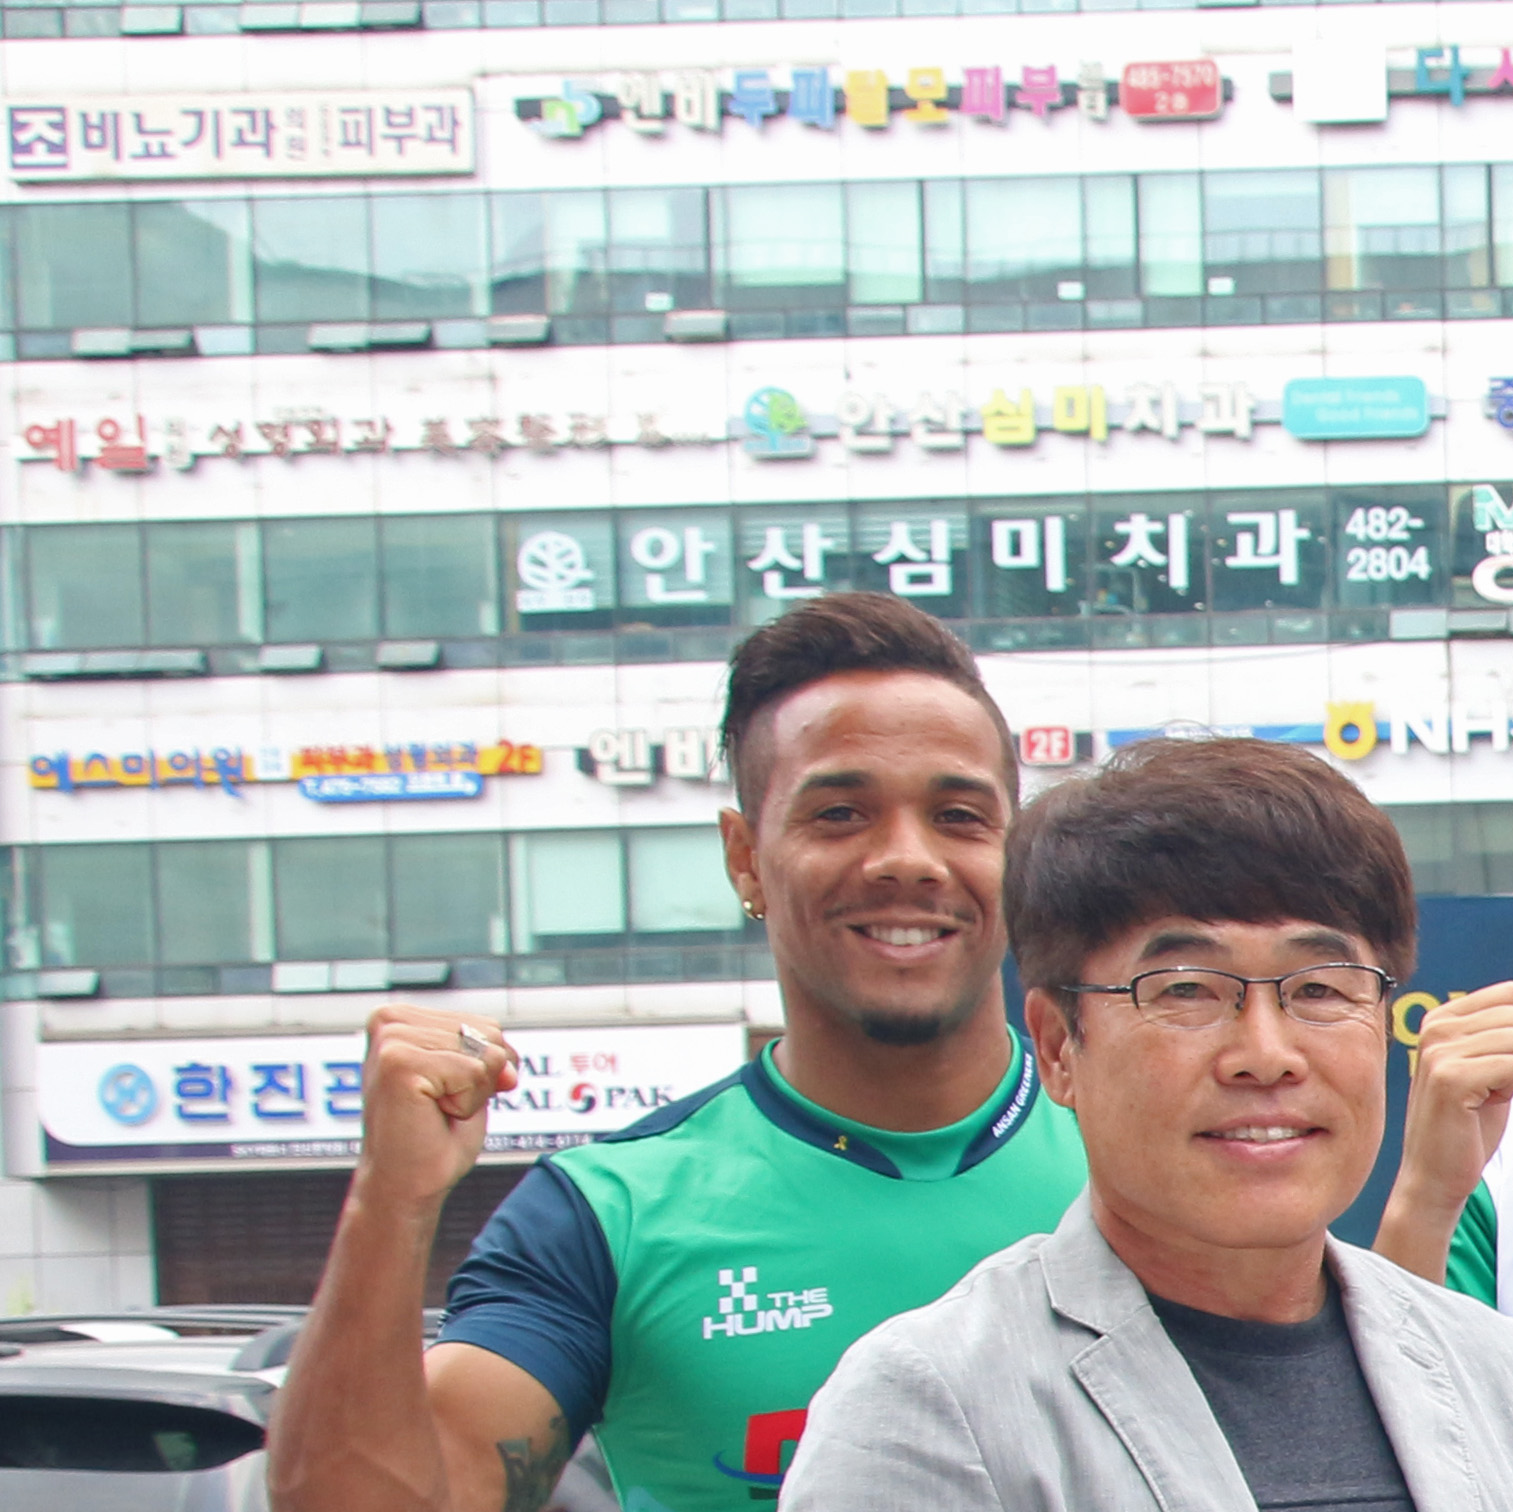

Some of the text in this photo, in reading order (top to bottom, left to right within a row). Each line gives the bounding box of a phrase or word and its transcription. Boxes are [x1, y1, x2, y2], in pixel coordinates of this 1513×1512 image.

[79, 107, 277, 162] 비뇨기과
[336, 103, 464, 157] 피부과
[836, 382, 1256, 453] 안산심미치과
[1345, 508, 1424, 541] 482-
[630, 510, 1311, 605] 안산심미치과
[1346, 547, 1432, 582] 2804
[496, 738, 534, 772] 2F
[1028, 730, 1066, 761] 2F
[570, 1052, 619, 1077] 투어
[603, 1086, 674, 1108] PAK
[992, 1102, 1022, 1139] ANSAN
[766, 1287, 829, 1308] THE
[702, 1303, 834, 1340] HUMP
